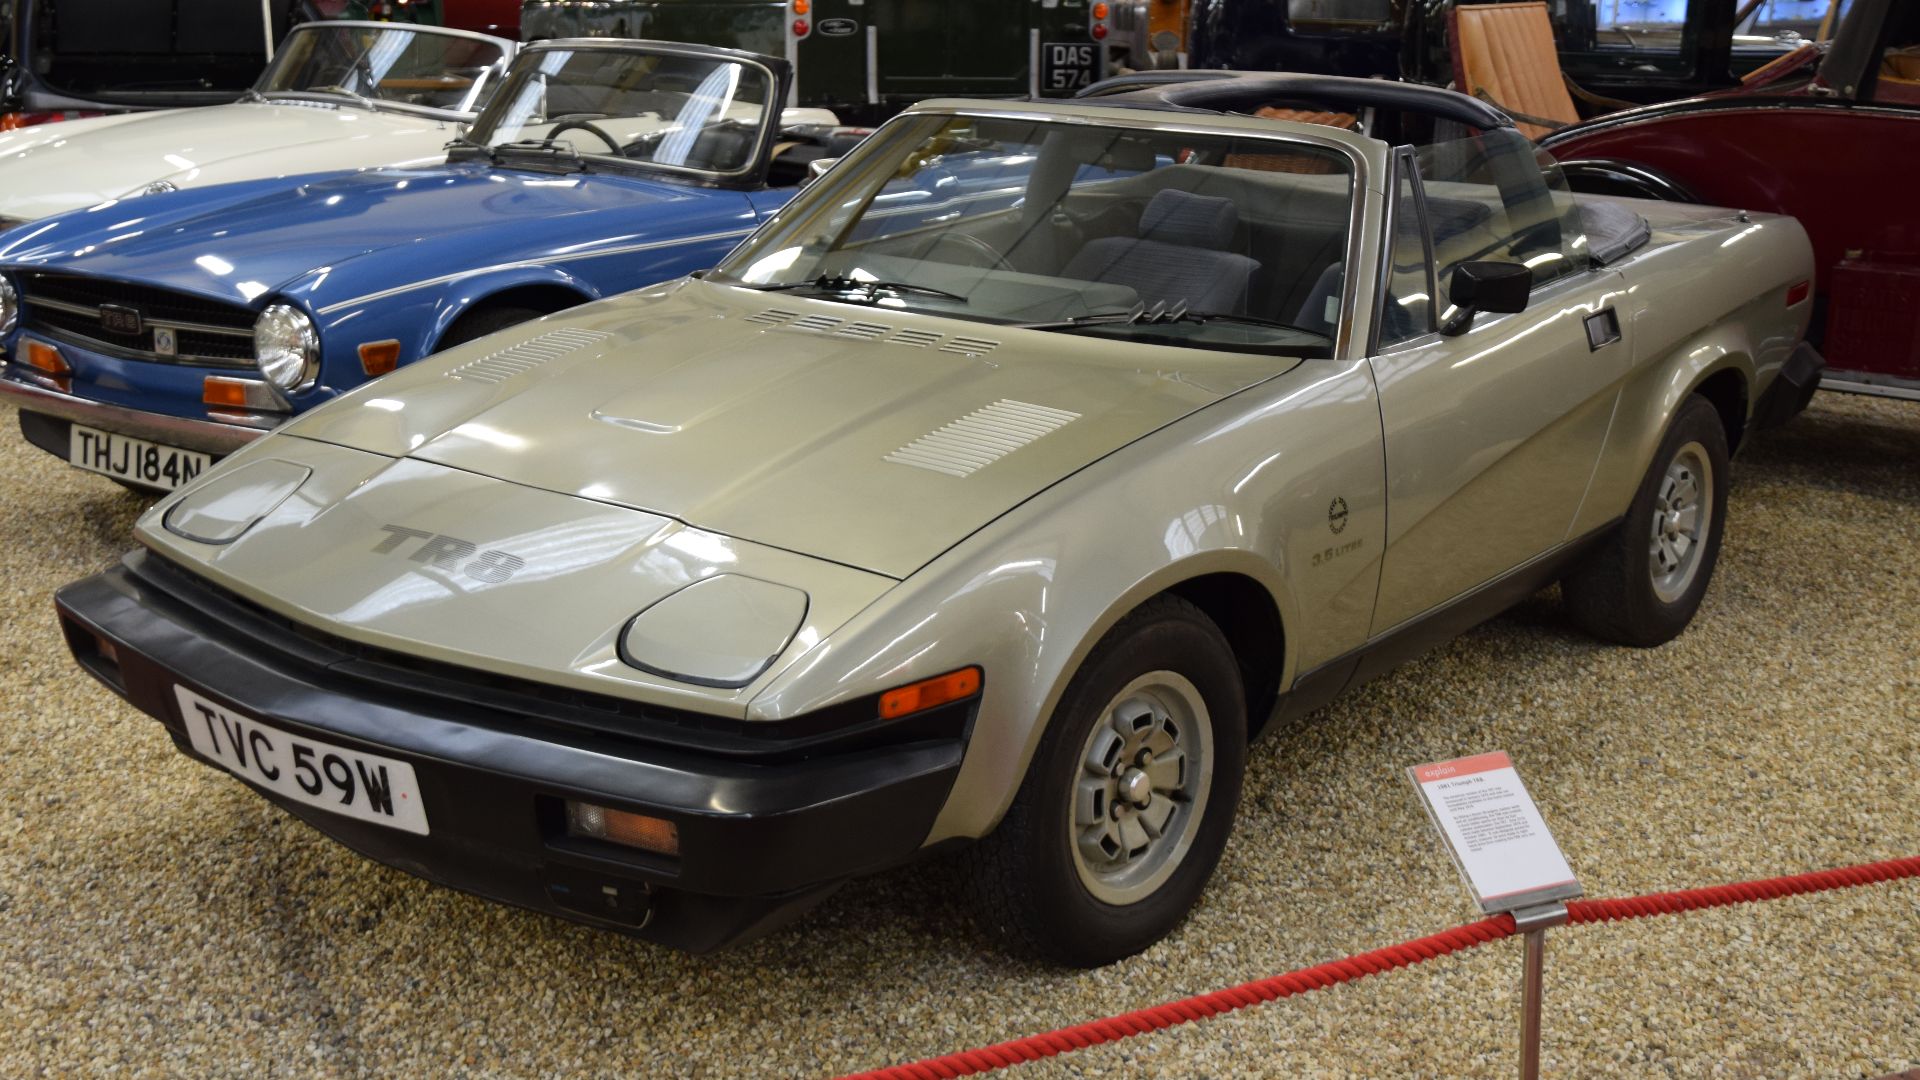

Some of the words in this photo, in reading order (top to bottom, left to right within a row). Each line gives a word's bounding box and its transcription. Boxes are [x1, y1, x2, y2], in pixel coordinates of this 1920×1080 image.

[1053, 46, 1092, 65] DAS
[1053, 69, 1091, 88] 574
[369, 523, 526, 584] TR8
[1311, 547, 1334, 568] 3.5
[194, 701, 281, 782] TVC
[292, 742, 395, 817] 59W
[1424, 766, 1456, 778] explain
[1451, 778, 1473, 788] Triumph
